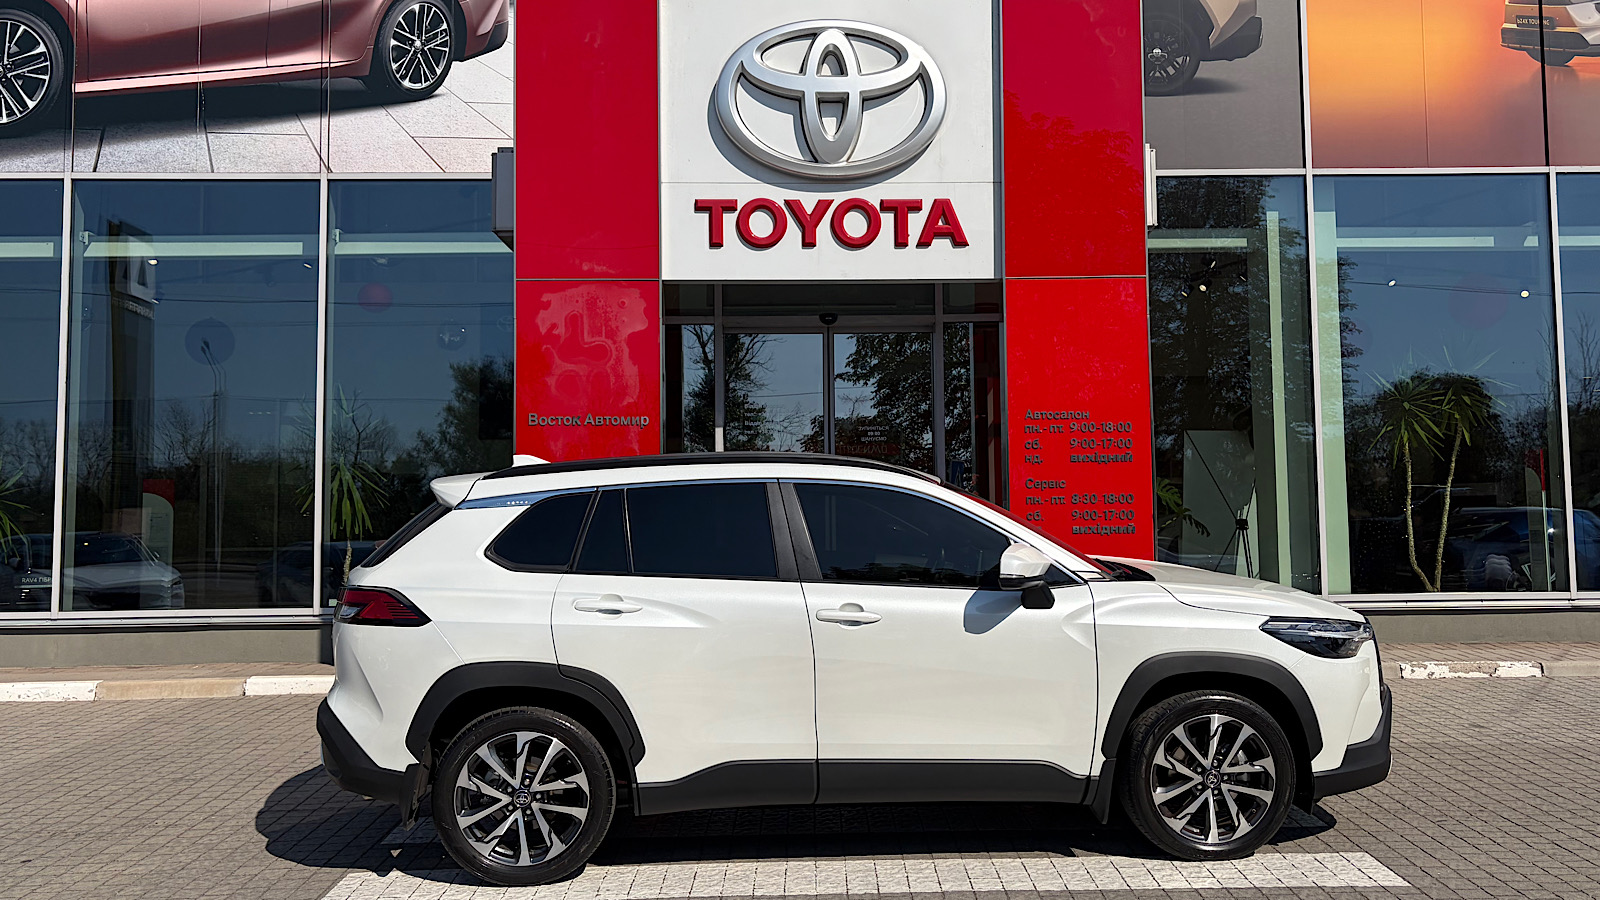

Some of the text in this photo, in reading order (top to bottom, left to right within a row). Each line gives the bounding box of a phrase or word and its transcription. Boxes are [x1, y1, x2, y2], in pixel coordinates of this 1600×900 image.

[694, 197, 970, 250] TOYOTA
[1024, 409, 1090, 420] Автосалон
[528, 413, 650, 429] Восток Автомир
[1069, 421, 1133, 433] 9:00-18:00
[1024, 438, 1133, 450] сб. 9:00-17:00
[1024, 451, 1133, 465] нд. вихідний
[1025, 478, 1067, 491] Сервіс
[1071, 493, 1135, 505] 8:30-18:00
[1026, 509, 1135, 521] сб. 9:00-17:00
[1072, 522, 1136, 536] вихідний
